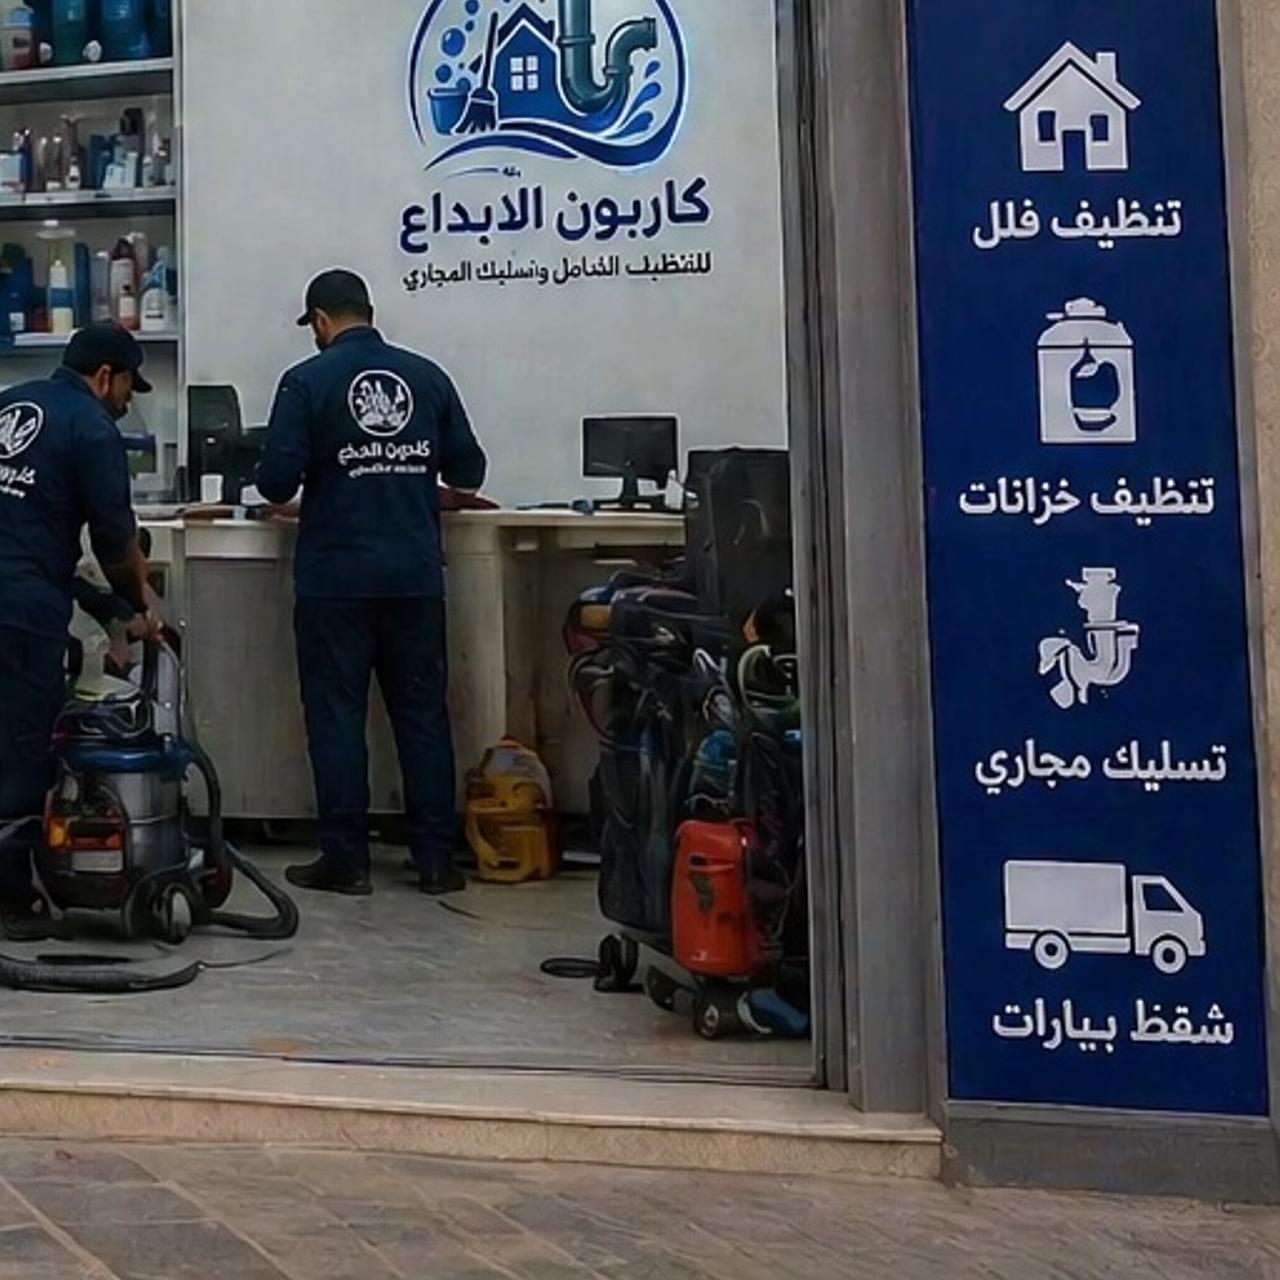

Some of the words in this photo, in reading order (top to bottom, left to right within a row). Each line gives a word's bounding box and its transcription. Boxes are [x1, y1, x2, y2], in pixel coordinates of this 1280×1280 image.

[400, 185, 543, 254] الابداع
[556, 177, 710, 241] كاربون
[973, 199, 1040, 249] فلل
[1051, 198, 1182, 249] تنظيف
[959, 477, 1081, 525] خزانات
[1091, 477, 1214, 526] تنظيف
[975, 739, 1091, 795] مجاري
[1102, 740, 1227, 792] تسليك
[993, 997, 1117, 1053] بيارات
